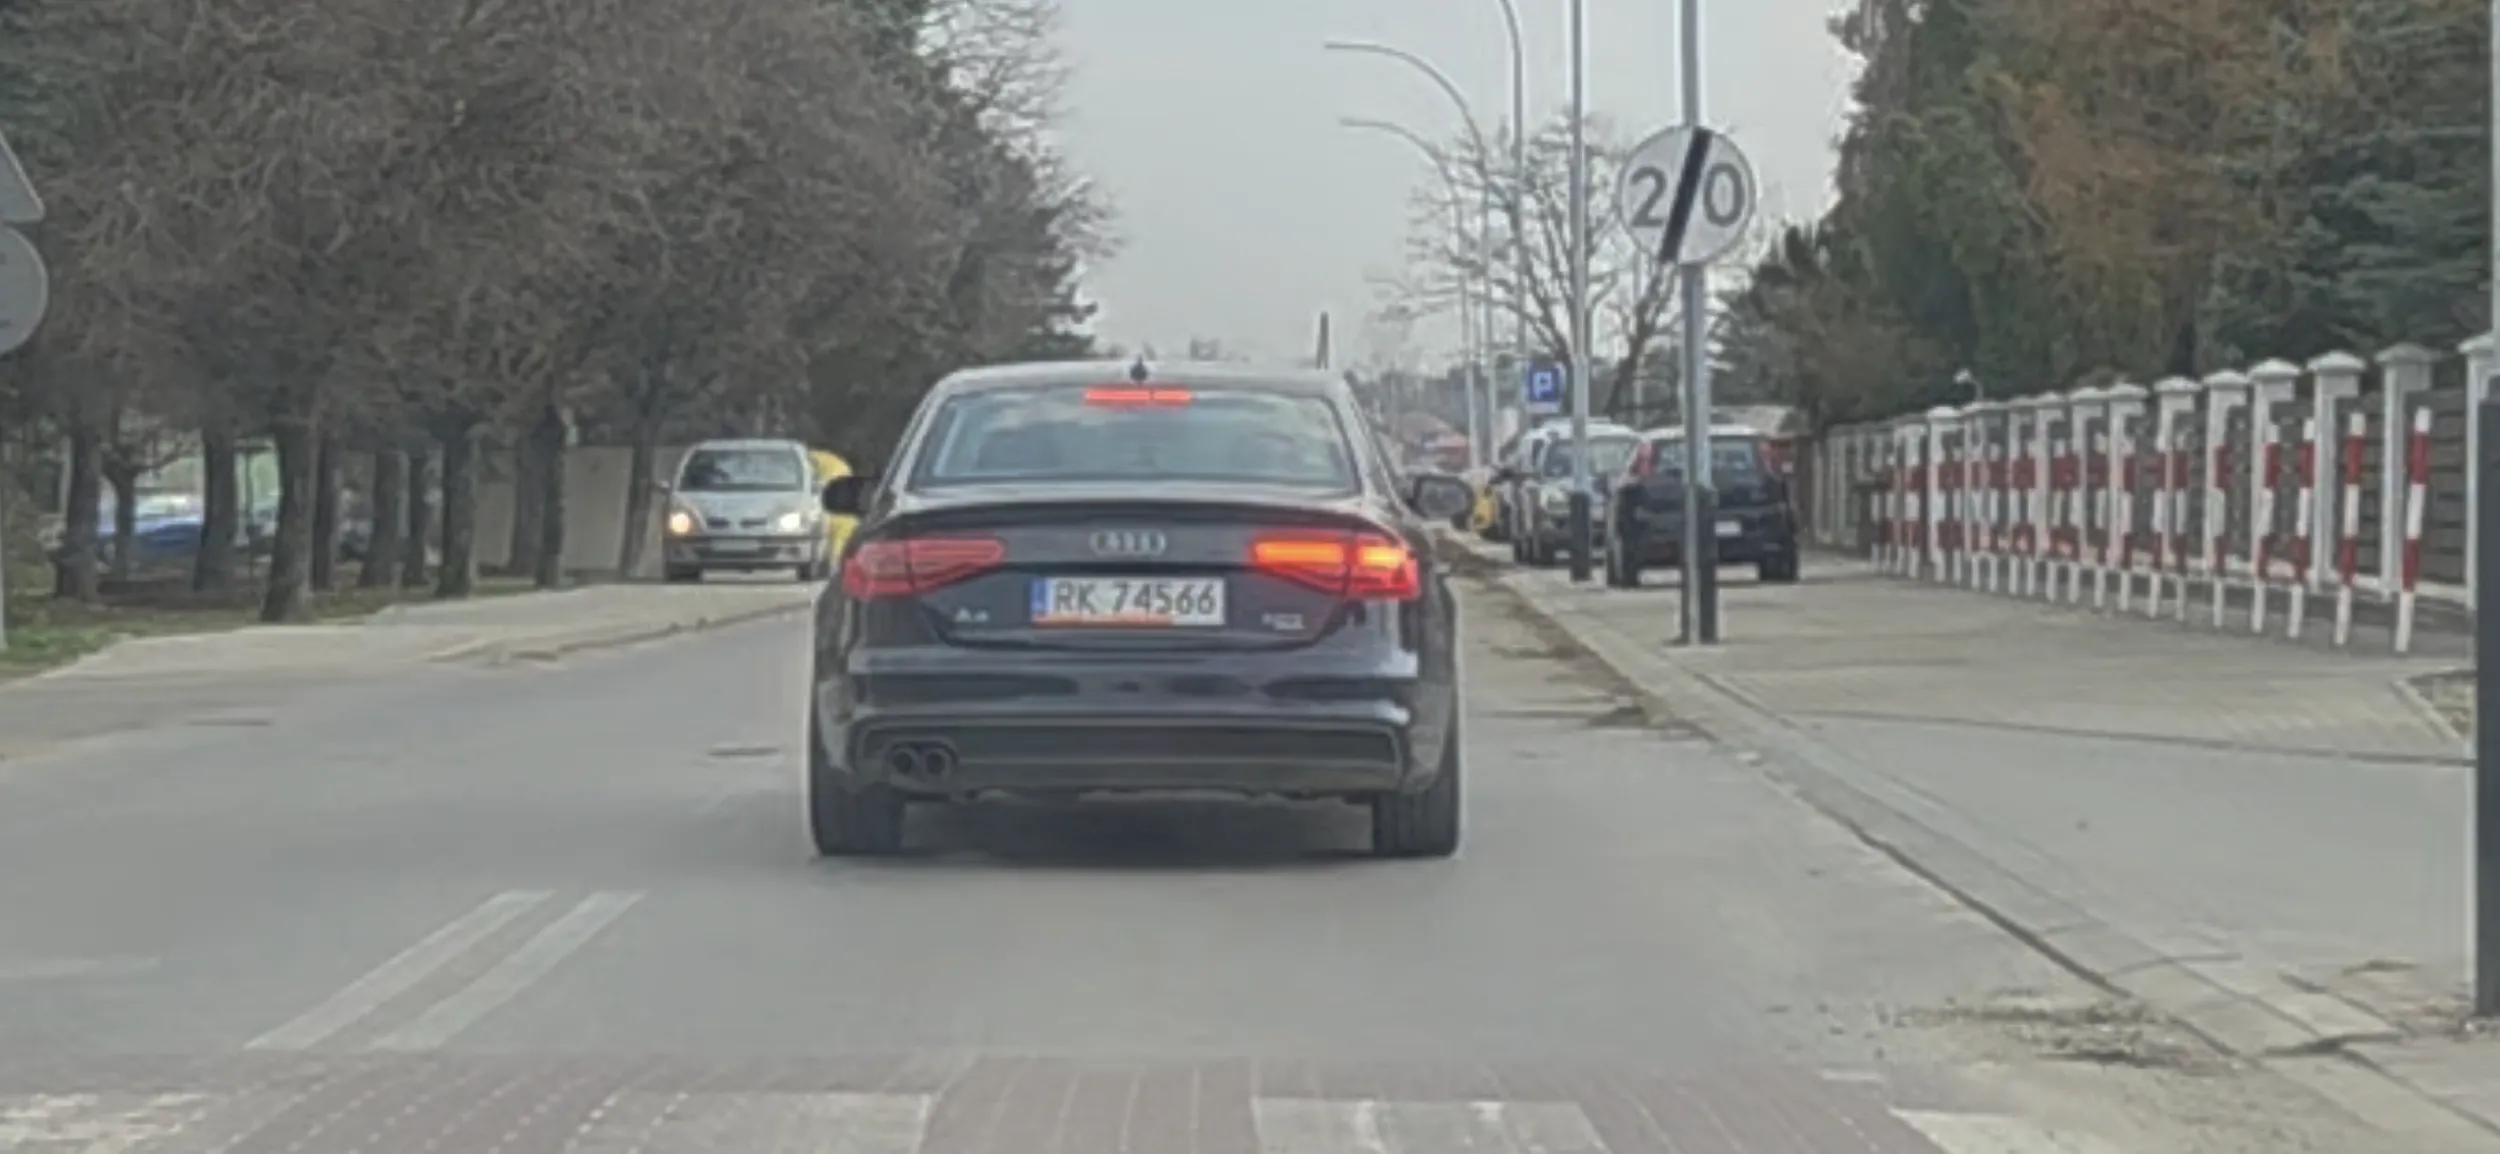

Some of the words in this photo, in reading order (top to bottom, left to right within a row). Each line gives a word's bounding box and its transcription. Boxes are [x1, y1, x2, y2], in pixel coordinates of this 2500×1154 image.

[1630, 161, 1745, 228] 20
[1533, 371, 1551, 399] P
[1055, 580, 1097, 614] RK
[1112, 582, 1217, 616] 74566
